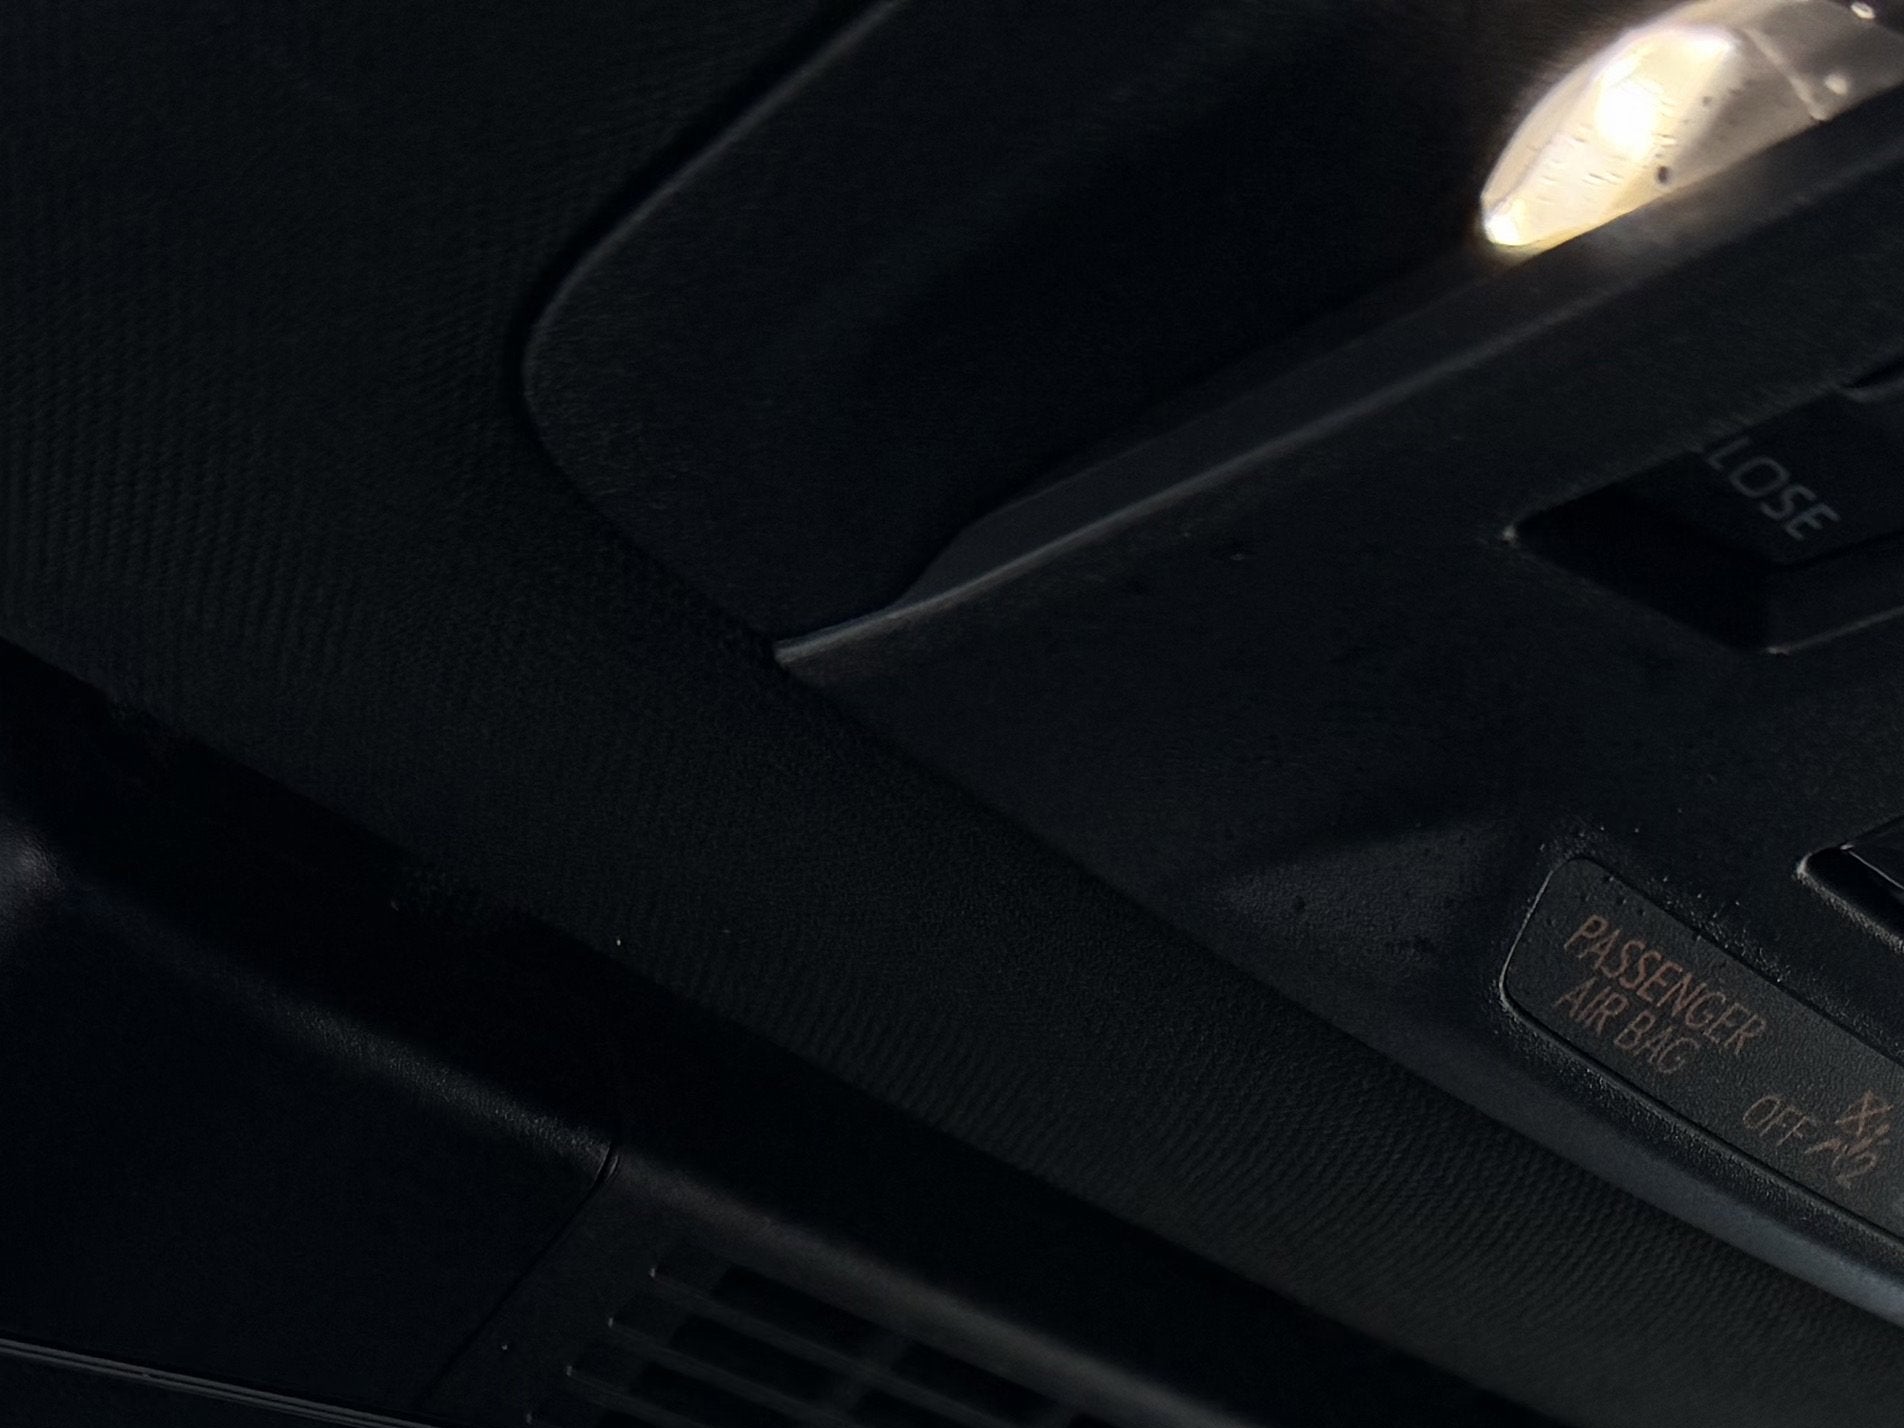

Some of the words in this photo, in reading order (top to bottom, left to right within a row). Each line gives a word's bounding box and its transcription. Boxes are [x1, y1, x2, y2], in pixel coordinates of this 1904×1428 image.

[1705, 436, 1841, 541] LOSE
[1553, 976, 1631, 1035] AIR
[1613, 1010, 1700, 1074] BAG
[1563, 913, 1767, 1056] PASSENGER
[1742, 1094, 1819, 1150] OFF
